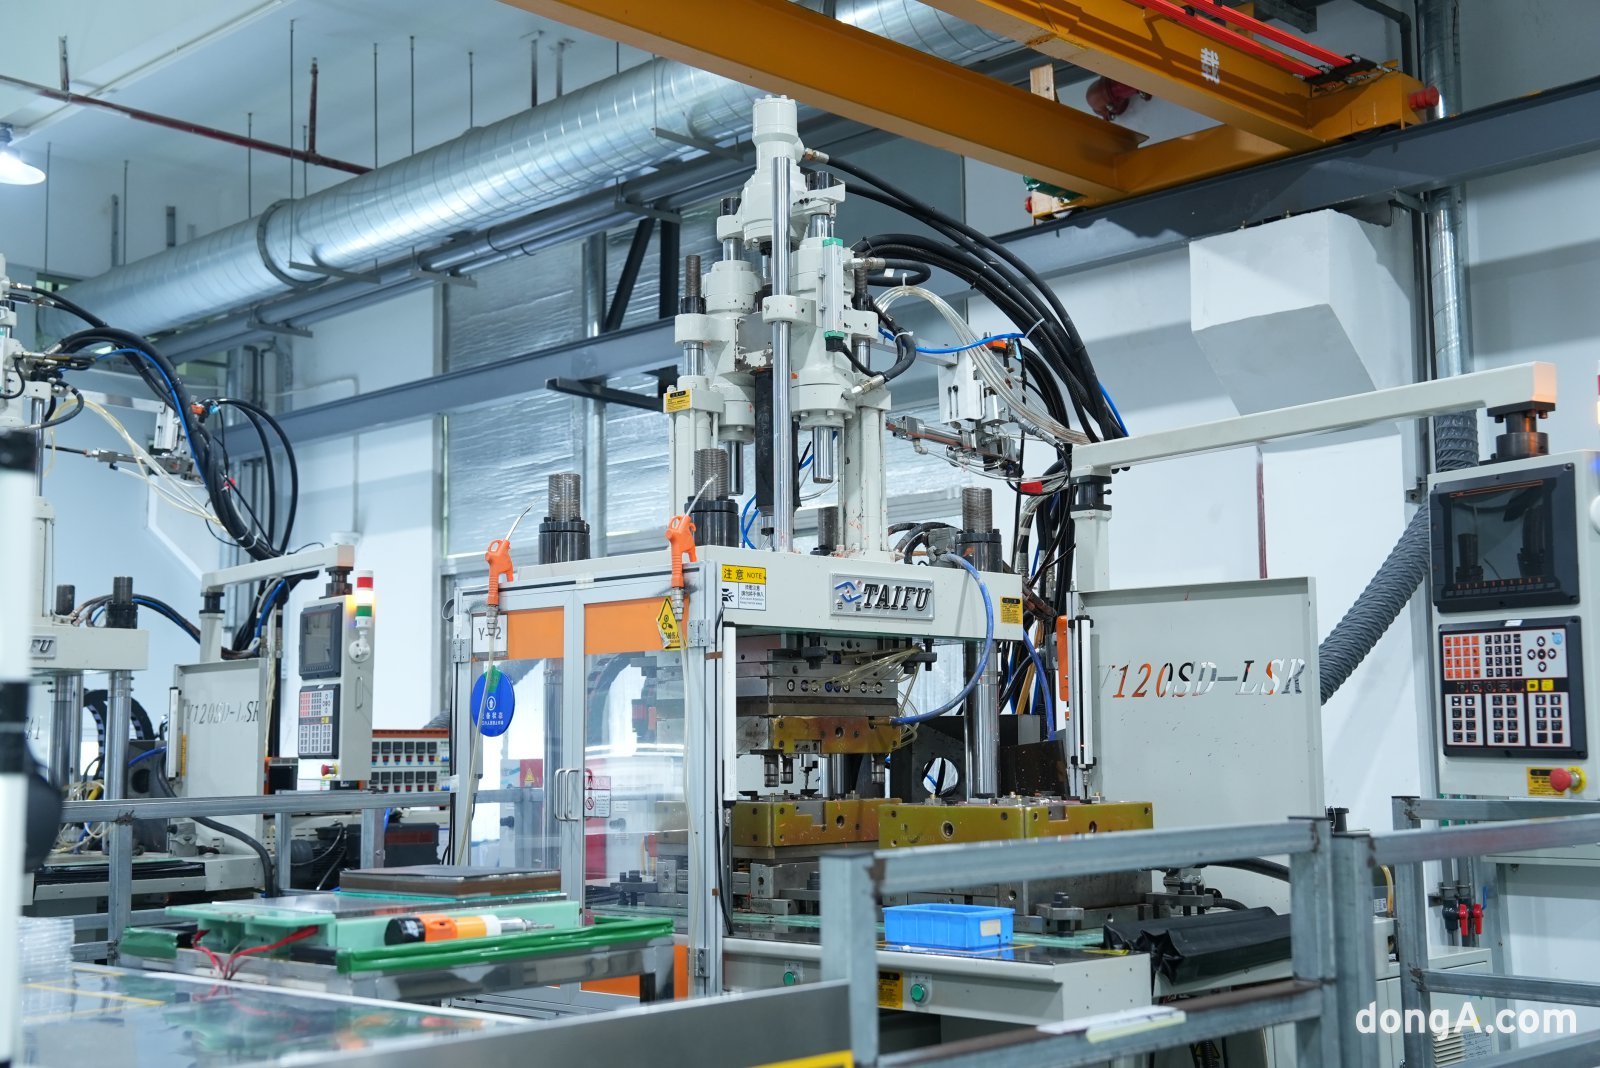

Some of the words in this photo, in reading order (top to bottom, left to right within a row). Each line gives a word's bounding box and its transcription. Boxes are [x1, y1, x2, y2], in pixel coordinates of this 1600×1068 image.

[724, 568, 743, 580] 注意
[747, 572, 763, 580] NOTE
[863, 583, 932, 611] TAIFU
